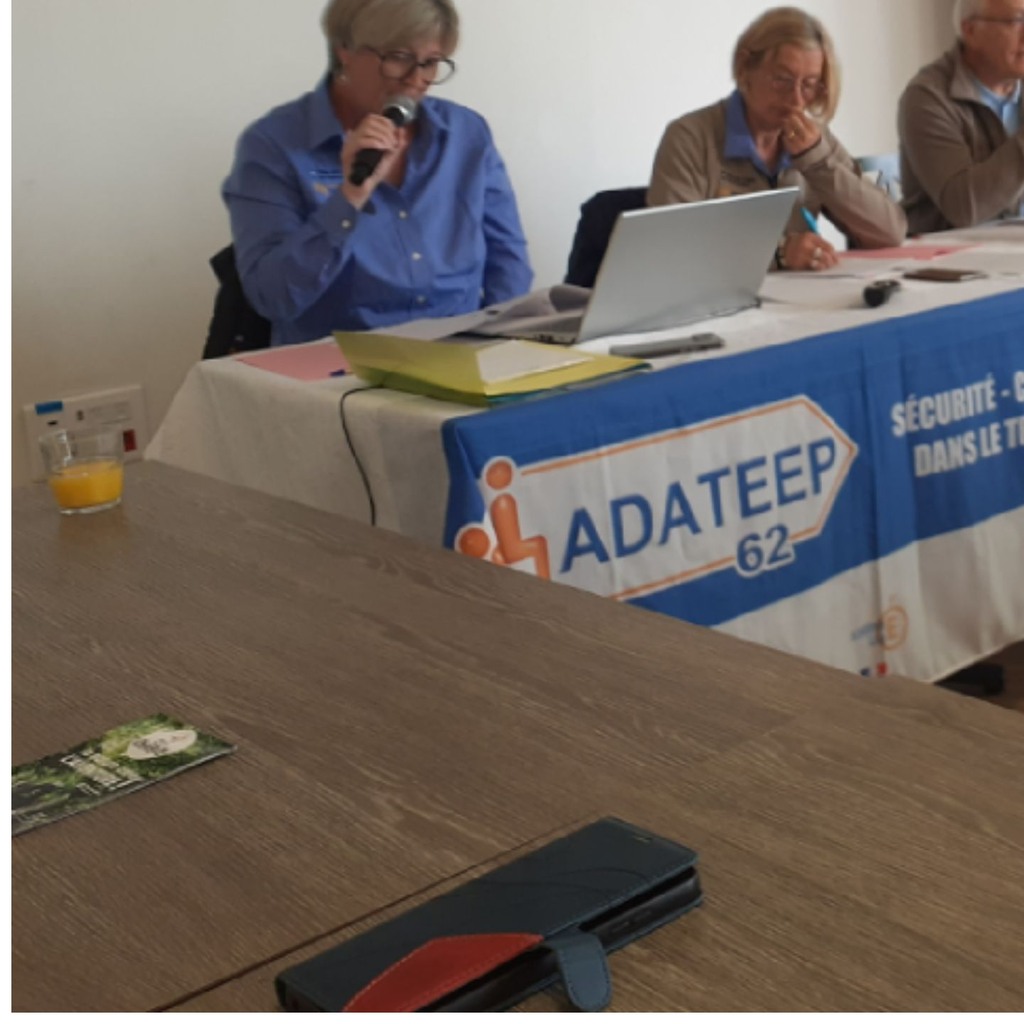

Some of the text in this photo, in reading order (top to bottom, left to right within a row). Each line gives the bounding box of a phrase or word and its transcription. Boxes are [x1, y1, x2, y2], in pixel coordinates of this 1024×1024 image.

[891, 372, 996, 437] SÉCURITÉ
[914, 428, 978, 477] DANS
[979, 422, 1002, 458] LE
[560, 437, 837, 574] ADATEEP
[734, 523, 793, 576] 62
